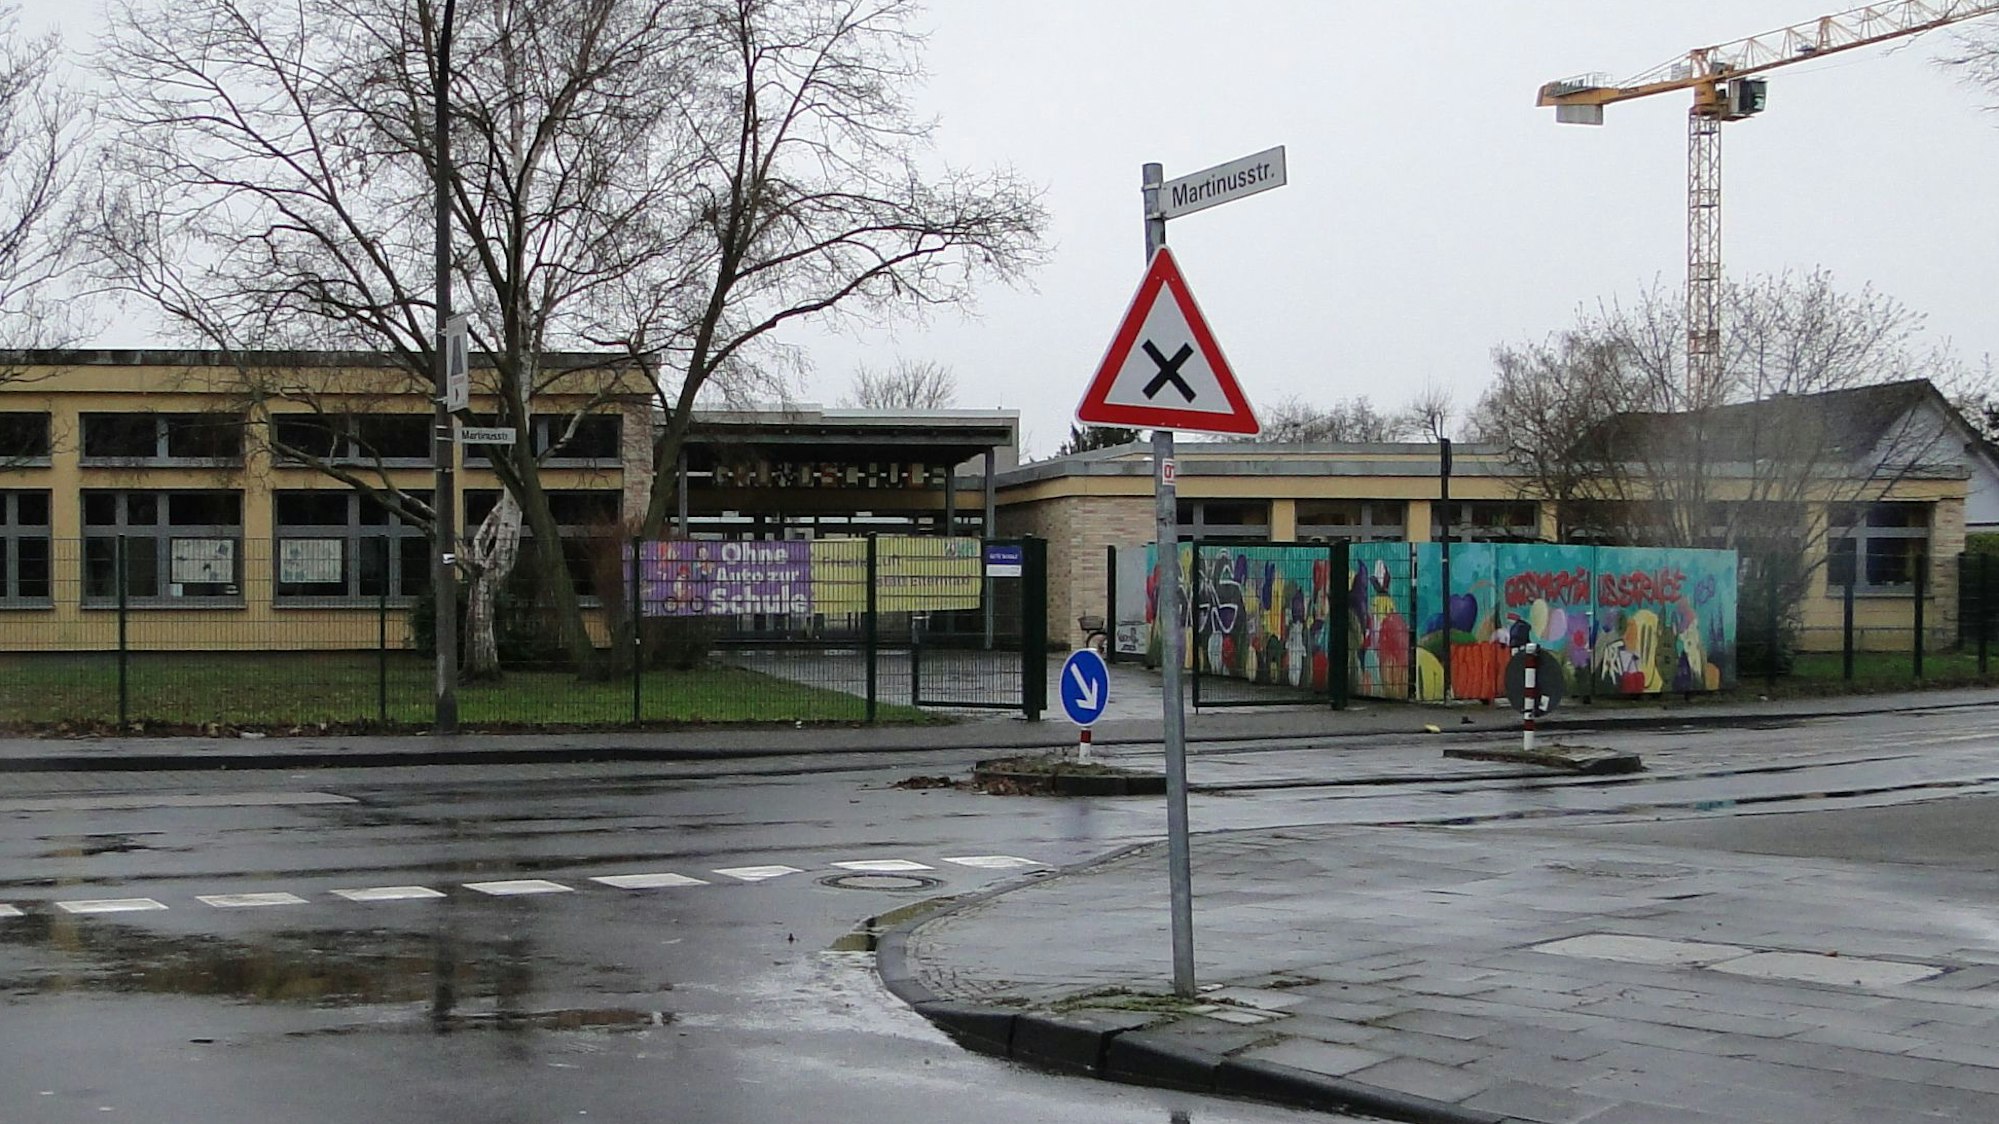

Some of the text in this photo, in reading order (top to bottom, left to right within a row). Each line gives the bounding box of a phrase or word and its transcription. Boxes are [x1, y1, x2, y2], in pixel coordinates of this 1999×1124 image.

[1171, 162, 1275, 208] Martinusstr.
[722, 541, 788, 565] Ohne
[716, 567, 800, 585] Auto zur
[708, 584, 808, 614] Schule
